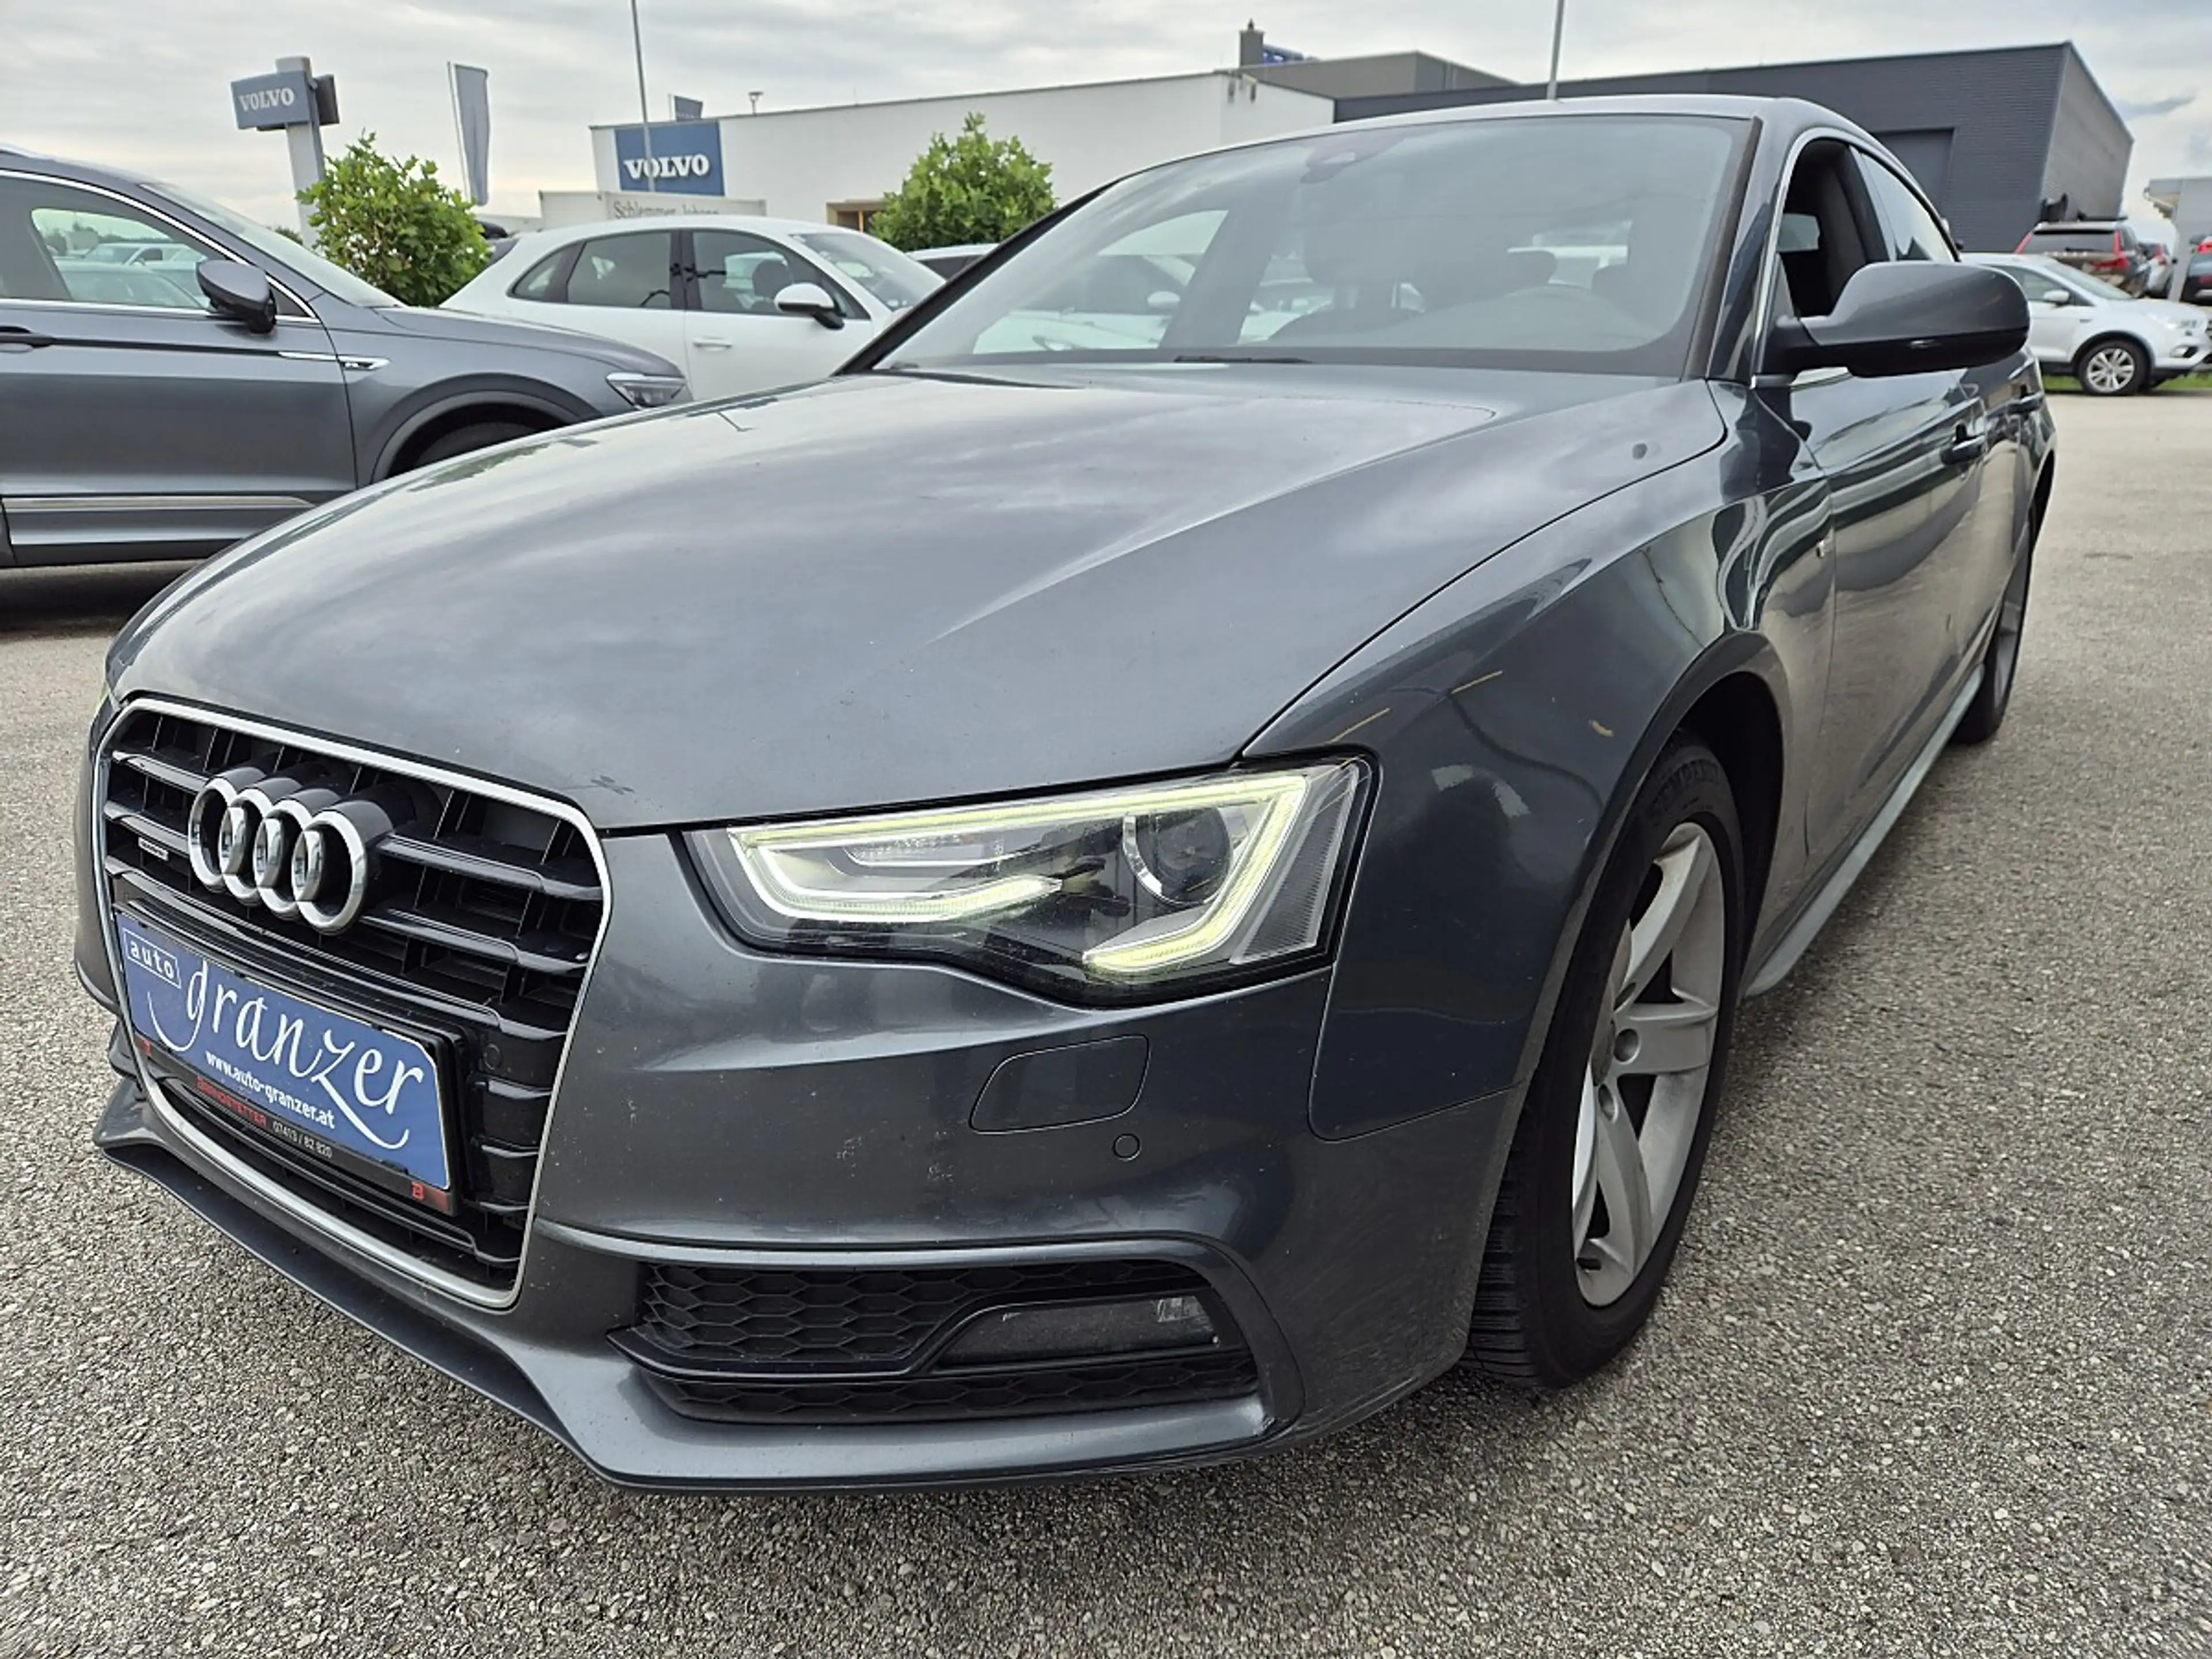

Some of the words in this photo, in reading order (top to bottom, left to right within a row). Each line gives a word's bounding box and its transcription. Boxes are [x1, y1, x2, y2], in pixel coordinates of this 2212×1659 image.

[238, 87, 294, 112] VOLVO
[623, 153, 710, 180] VOLVO
[130, 940, 174, 979] auto
[147, 957, 425, 1149] granzer
[205, 1050, 335, 1130] www.auto-granzer.at
